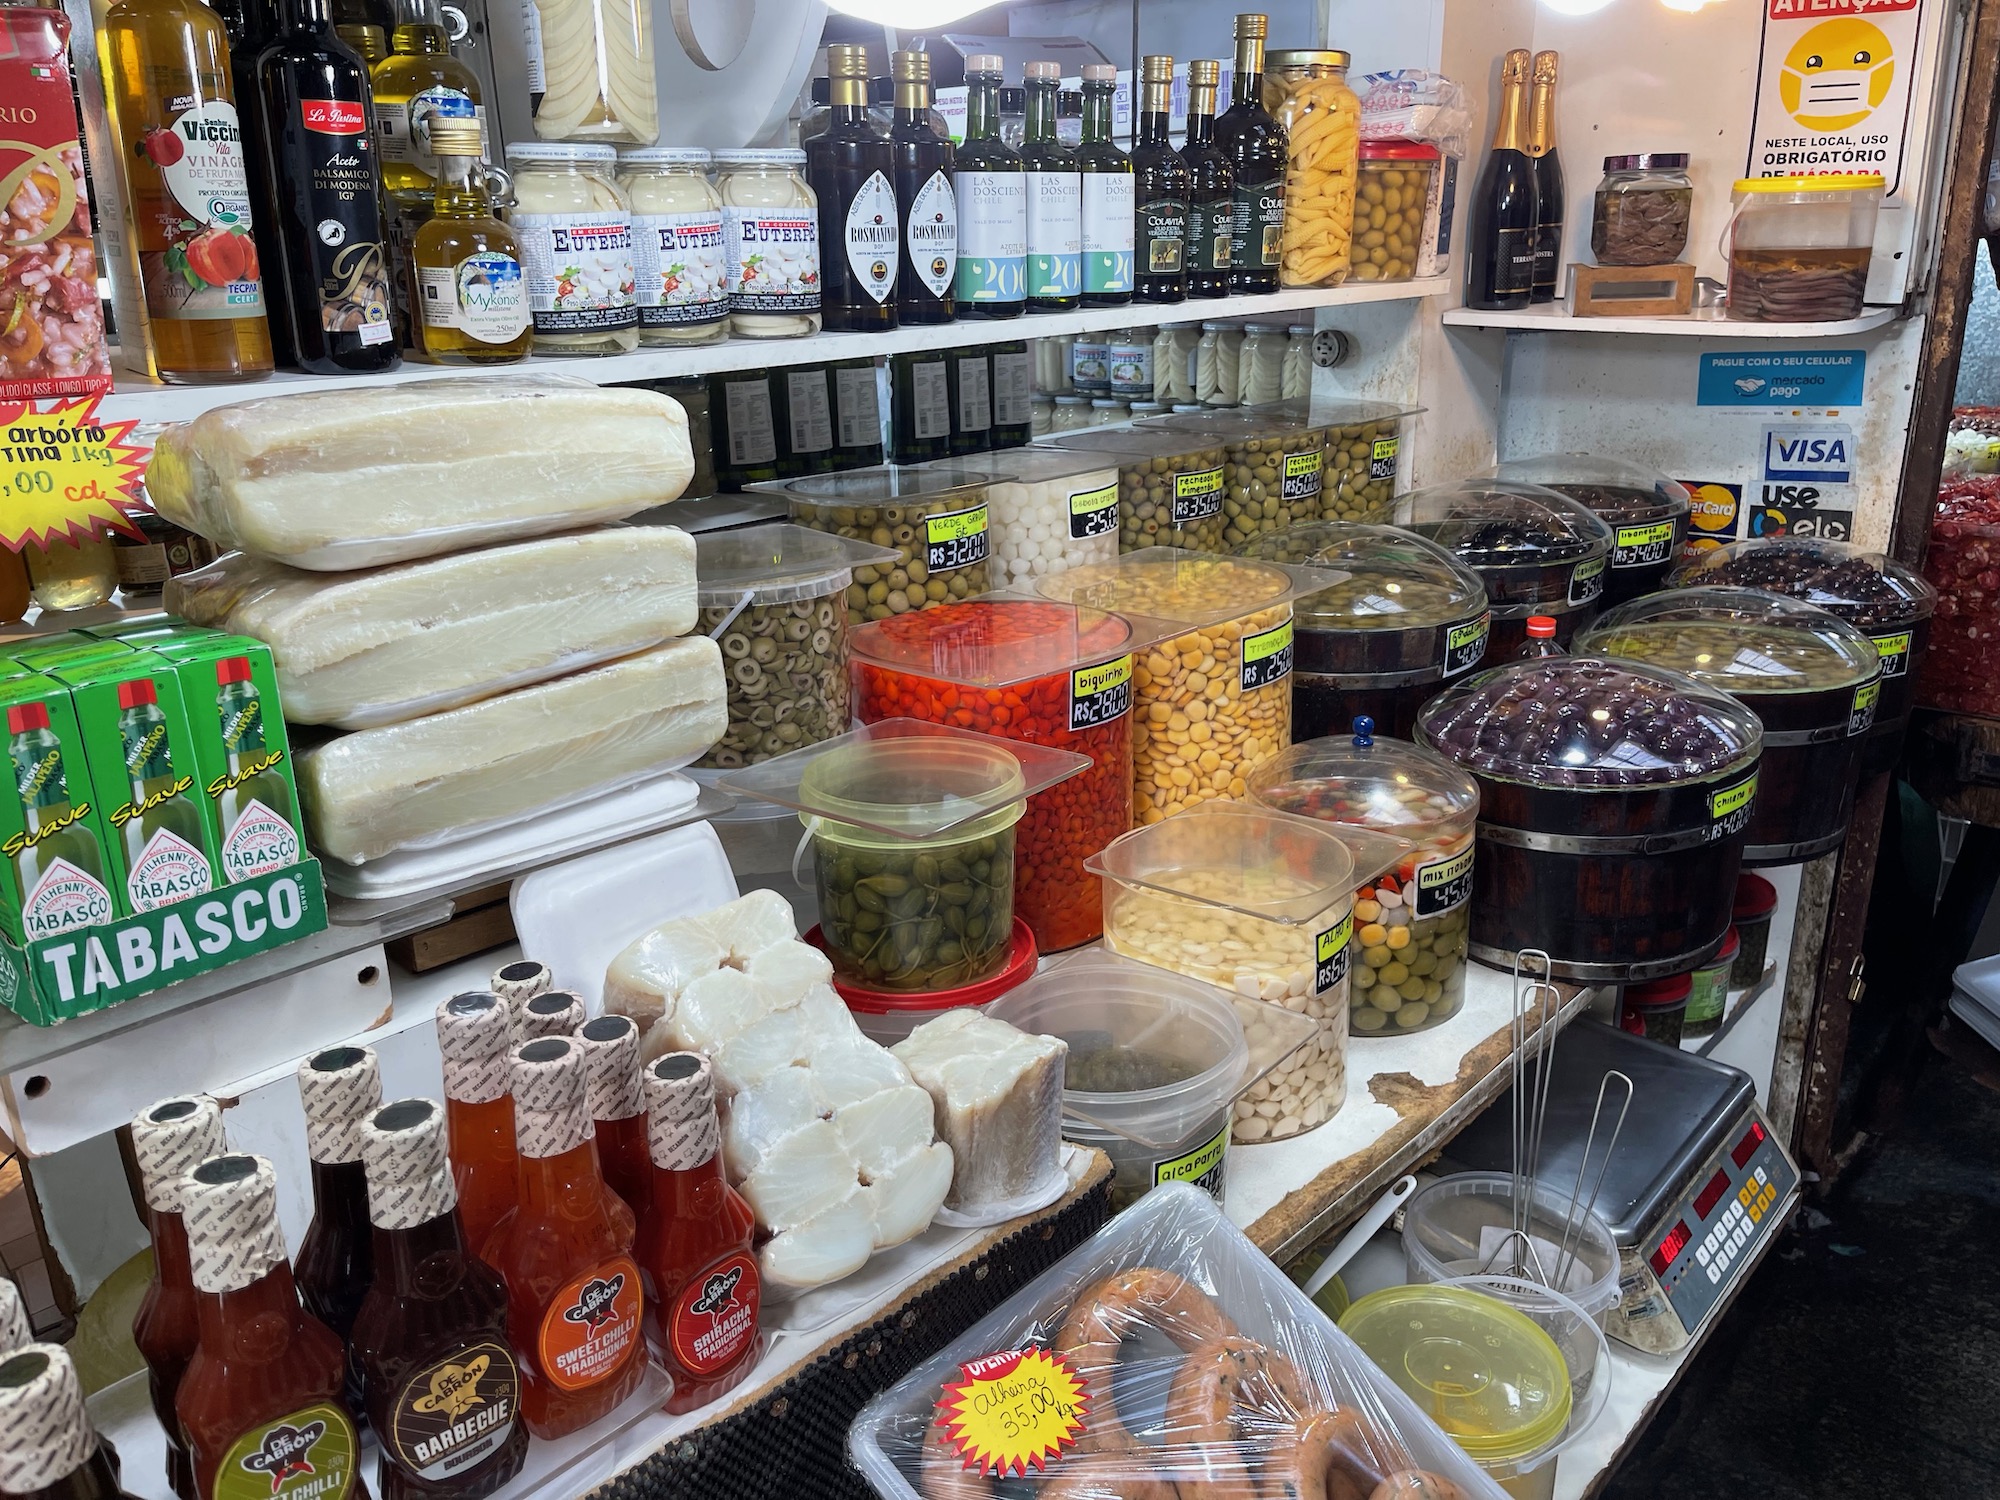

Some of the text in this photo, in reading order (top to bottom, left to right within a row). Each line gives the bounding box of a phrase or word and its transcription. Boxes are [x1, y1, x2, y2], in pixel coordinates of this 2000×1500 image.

[1774, 0, 1909, 13] ATENÇ
[173, 96, 193, 105] NOVA
[308, 108, 362, 125] La Pastina
[209, 141, 231, 155] Vita
[1765, 135, 1888, 148] NESTE LOCAL, USO
[187, 156, 244, 167] VINAGR
[326, 153, 360, 167] Aceto
[1764, 148, 1887, 165] OBRIGATÓRIO
[189, 169, 232, 178] DE FRUTA
[313, 168, 370, 179] BALSAMICO
[973, 177, 994, 186] LAS
[1041, 177, 1060, 185] LAS
[1106, 177, 1122, 185] LAS
[198, 189, 230, 197] PRODUTO
[315, 180, 371, 191] DI MODENA
[339, 192, 354, 200] IGP
[588, 227, 624, 235] CONSERVA
[741, 221, 815, 242] EUTERPE
[1148, 216, 1185, 226] COLAVITA
[552, 226, 631, 252] EUTERPE
[228, 282, 258, 294] TECPAR
[235, 295, 254, 304] CERT
[466, 293, 519, 311] Mykonos
[496, 324, 517, 333] 250ml
[1712, 356, 1852, 367] PAGUE COM O SEU CELULAR
[55, 379, 101, 394] LONGO TIPO
[1771, 375, 1825, 386] mercado
[1770, 386, 1801, 399] pago
[8, 419, 106, 444] arbório
[72, 446, 116, 468] 1kg
[1776, 438, 1846, 463] VISA
[1762, 485, 1820, 510] use
[932, 518, 961, 531] VERDE
[1793, 516, 1846, 541] elo
[1080, 667, 1123, 691] biquinho
[222, 711, 243, 741] MILDER
[225, 701, 260, 751] JALAPEÑO
[125, 735, 149, 767] MILDER
[129, 724, 166, 777] JALAPEÑO
[18, 761, 42, 795] MILDER
[22, 750, 61, 806] JALAPEÑO
[206, 750, 284, 799] Suave
[109, 775, 193, 828] Suave
[1, 801, 92, 858] Suave
[226, 838, 295, 869] TABASCO
[250, 862, 279, 876] BRAND
[132, 867, 208, 901] TABASCO
[158, 893, 190, 907] BRAND
[298, 884, 309, 912] BRAND
[26, 899, 108, 933] TABASCO
[43, 877, 301, 1003] TABASCO
[586, 1286, 602, 1304] DE
[698, 1274, 737, 1311] CABRÓN
[708, 1280, 721, 1296] DE
[572, 1281, 619, 1320] CABRÓN
[693, 1303, 752, 1353] SRIRACHA
[556, 1315, 635, 1369] SWEET CHILLI
[696, 1317, 753, 1361] TRADICIONAL
[565, 1333, 630, 1377] TRADICIONAL
[424, 1364, 483, 1410] CABRÓN
[438, 1373, 457, 1391] DE
[974, 1376, 1046, 1415] alheira
[999, 1386, 1055, 1438] 35,00
[413, 1398, 508, 1463] BARBECUE
[253, 1430, 316, 1469] CABRÓN
[270, 1434, 290, 1451] DE
[443, 1437, 494, 1471] BOURBON
[292, 1470, 341, 1500] CHILLI
